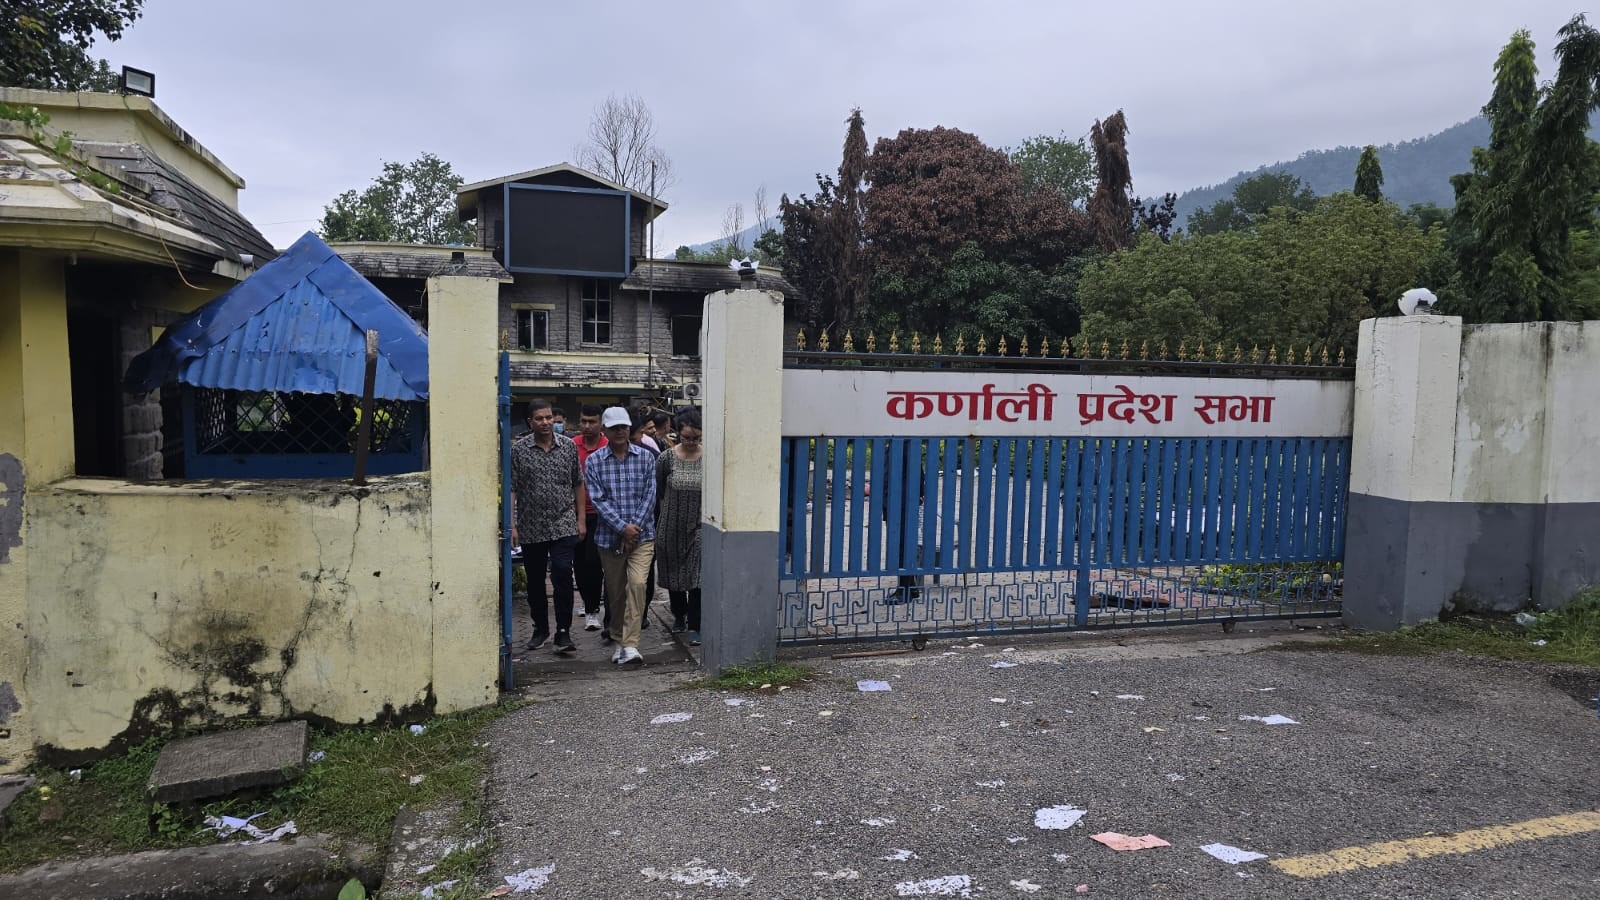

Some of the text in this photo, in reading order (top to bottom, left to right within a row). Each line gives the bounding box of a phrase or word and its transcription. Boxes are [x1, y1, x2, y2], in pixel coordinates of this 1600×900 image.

[886, 383, 1275, 425] कर्णाली प्रदेश सभा
